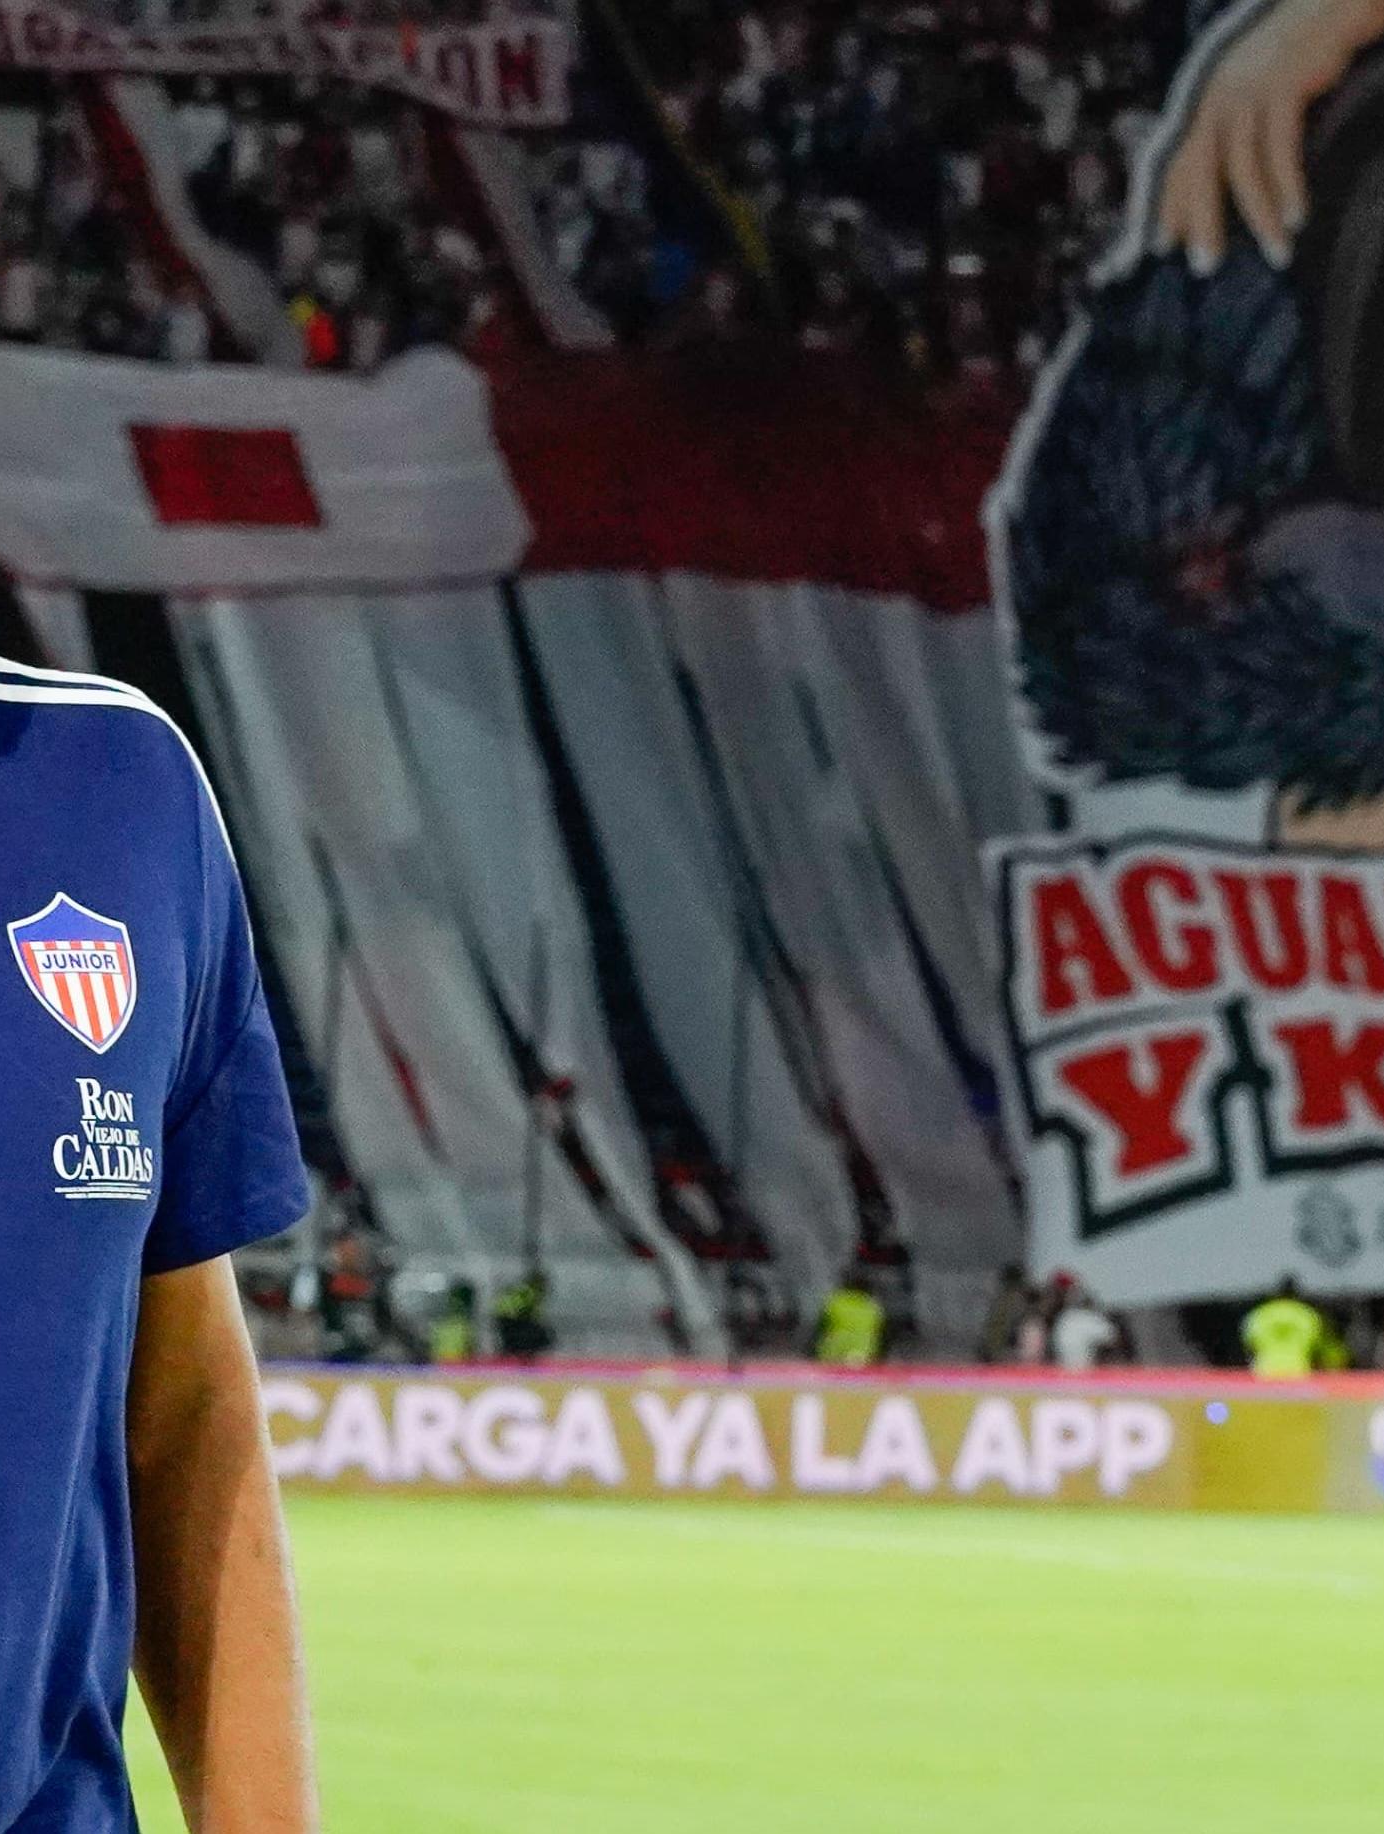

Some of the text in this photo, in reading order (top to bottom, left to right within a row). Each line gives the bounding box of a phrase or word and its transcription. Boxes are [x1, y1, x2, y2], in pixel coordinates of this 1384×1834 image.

[42, 953, 116, 970] JUNIOR
[75, 1077, 134, 1122] RON
[1060, 1029, 1209, 1178] Y
[52, 1134, 153, 1182] CALDAS
[268, 1379, 1174, 1496] CARGA YA LA APP
